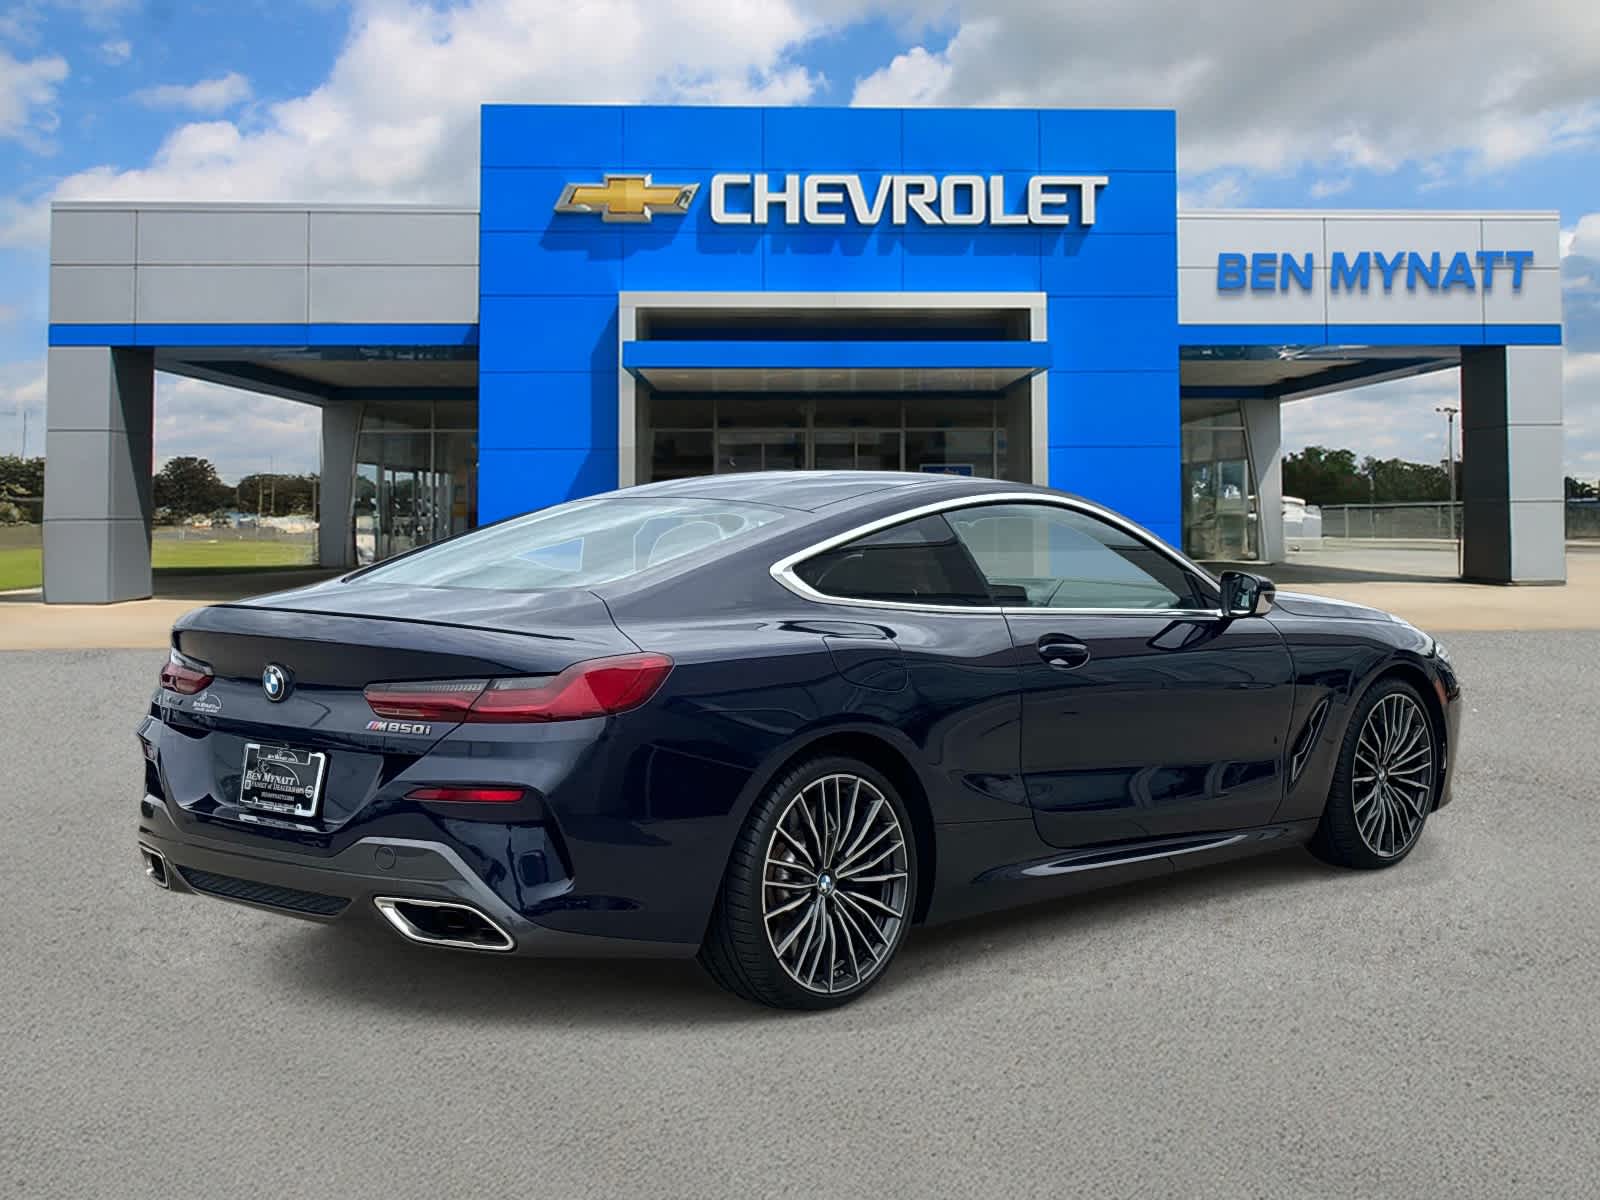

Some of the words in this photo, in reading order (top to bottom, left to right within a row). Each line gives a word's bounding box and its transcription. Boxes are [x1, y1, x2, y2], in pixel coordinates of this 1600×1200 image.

[711, 173, 1109, 226] CHEVROLET
[1217, 252, 1314, 292] BEN
[1330, 250, 1535, 292] MYNATT
[246, 770, 262, 781] BEN
[263, 772, 295, 785] MYNATT
